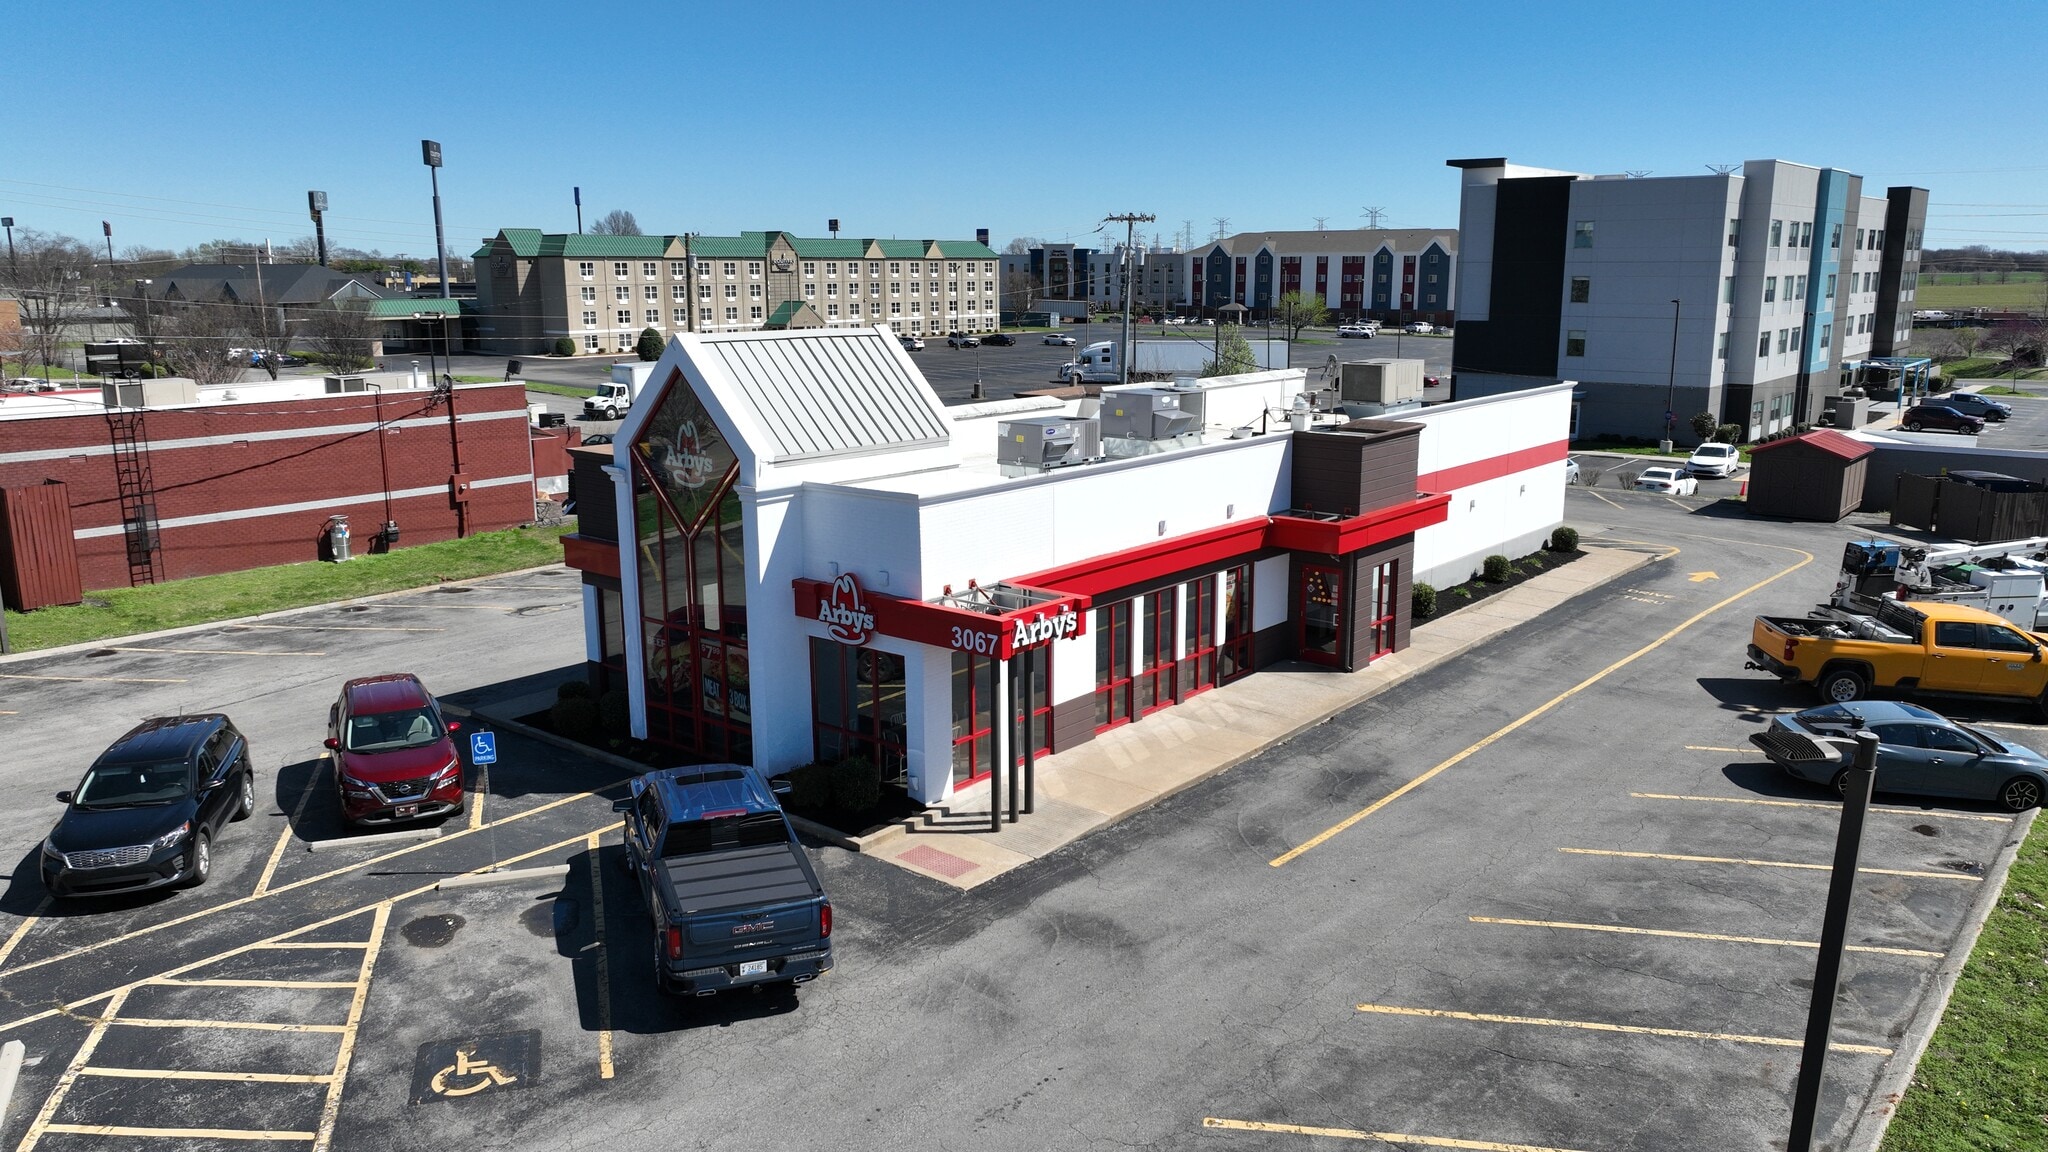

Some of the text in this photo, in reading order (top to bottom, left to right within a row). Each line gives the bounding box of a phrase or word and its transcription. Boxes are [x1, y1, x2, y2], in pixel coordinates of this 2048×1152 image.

[665, 444, 713, 476] Arby's
[1623, 594, 1666, 605] THRU
[1627, 588, 1677, 599] DRIVE
[818, 599, 875, 633] Arby's
[1012, 608, 1078, 649] Arby's
[951, 625, 998, 656] 3067
[704, 677, 720, 698] MEAT
[474, 754, 495, 762] PARKING
[732, 920, 775, 935] GMC
[733, 940, 773, 949] DENALI
